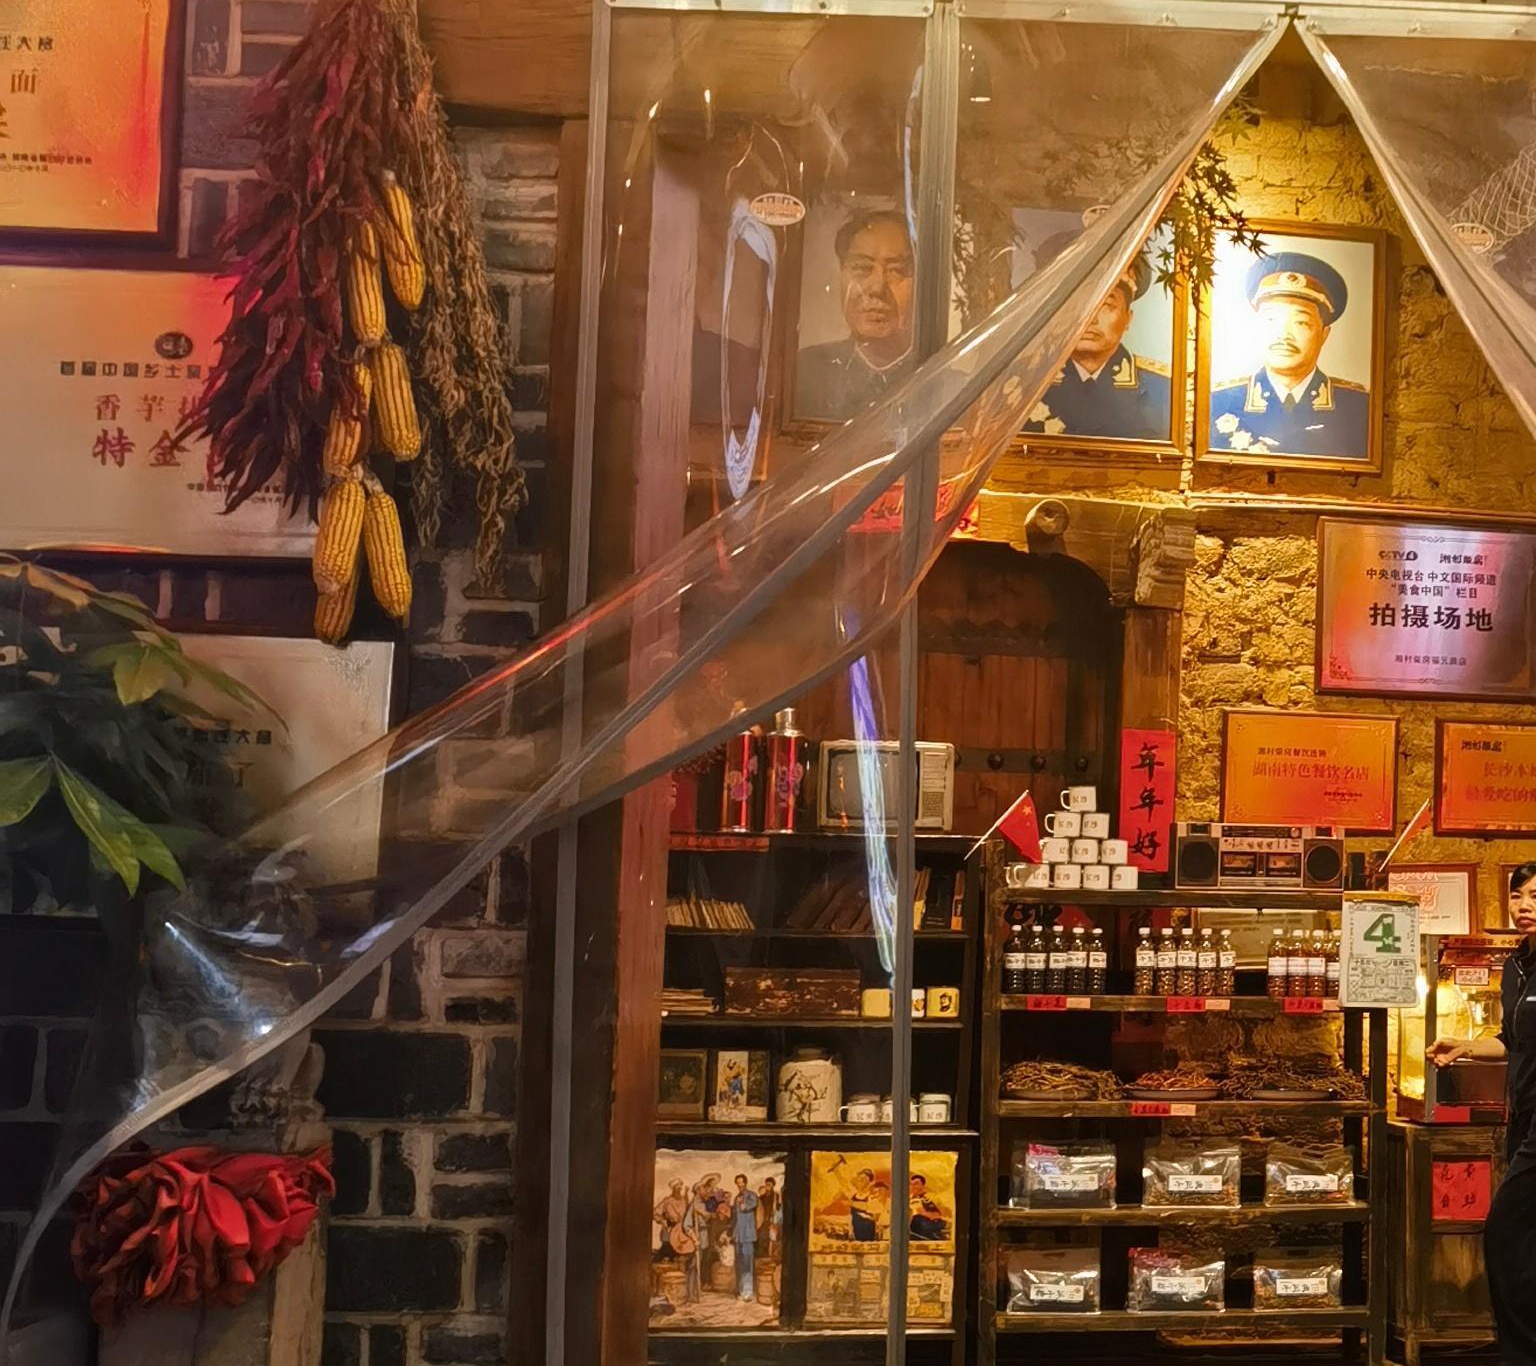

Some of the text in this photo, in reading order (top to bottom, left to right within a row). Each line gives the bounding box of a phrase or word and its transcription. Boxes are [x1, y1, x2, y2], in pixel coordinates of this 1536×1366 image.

[91, 426, 192, 469] 特金
[1366, 567, 1497, 586] 中央电视台 中文国际频道
[1369, 602, 1493, 633] 拍摄场地
[1129, 741, 1166, 861] 年年好
[1363, 913, 1402, 953] 4
